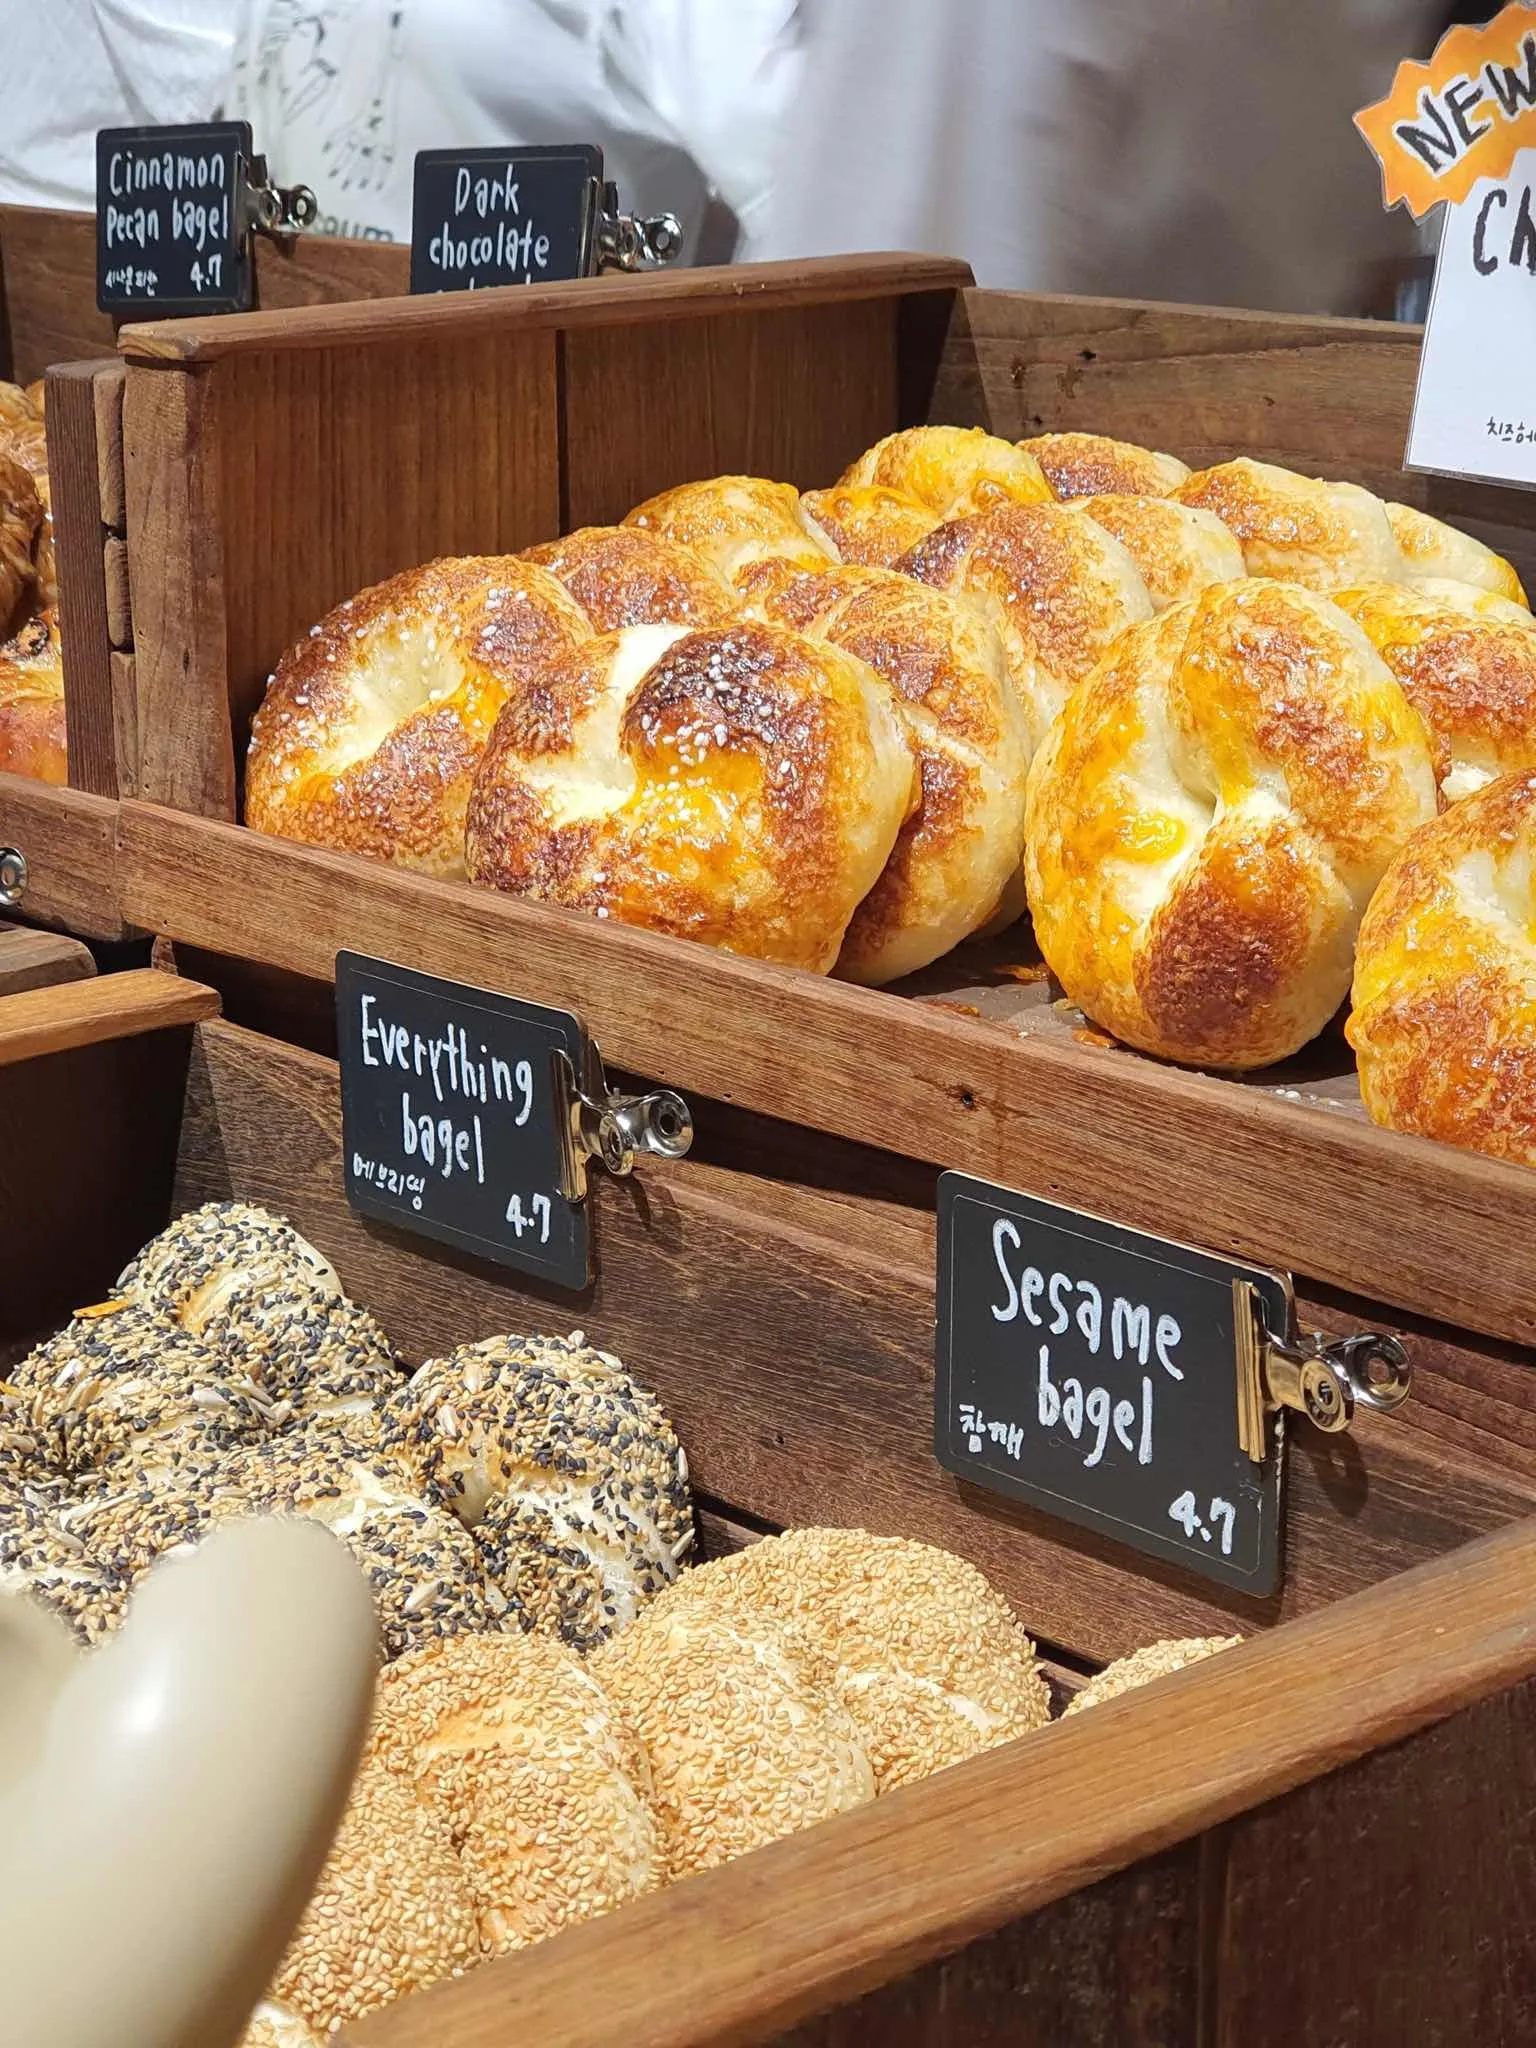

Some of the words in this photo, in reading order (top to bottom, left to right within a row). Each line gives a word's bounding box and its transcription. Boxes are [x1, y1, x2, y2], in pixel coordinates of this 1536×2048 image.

[1396, 38, 1536, 173] NEW
[109, 151, 226, 198] Cinnamon
[455, 163, 520, 218] Dark
[172, 194, 228, 252] bagel
[429, 219, 550, 272] chocolate
[190, 253, 222, 292] 4.7
[361, 994, 533, 1127] Everything
[402, 1092, 485, 1184] bagel
[506, 1193, 551, 1243] 4.7
[991, 1218, 1185, 1382] Sesame
[959, 1404, 1024, 1460] 참깨
[1038, 1344, 1154, 1467] bagel
[1168, 1490, 1235, 1555] 4.7
